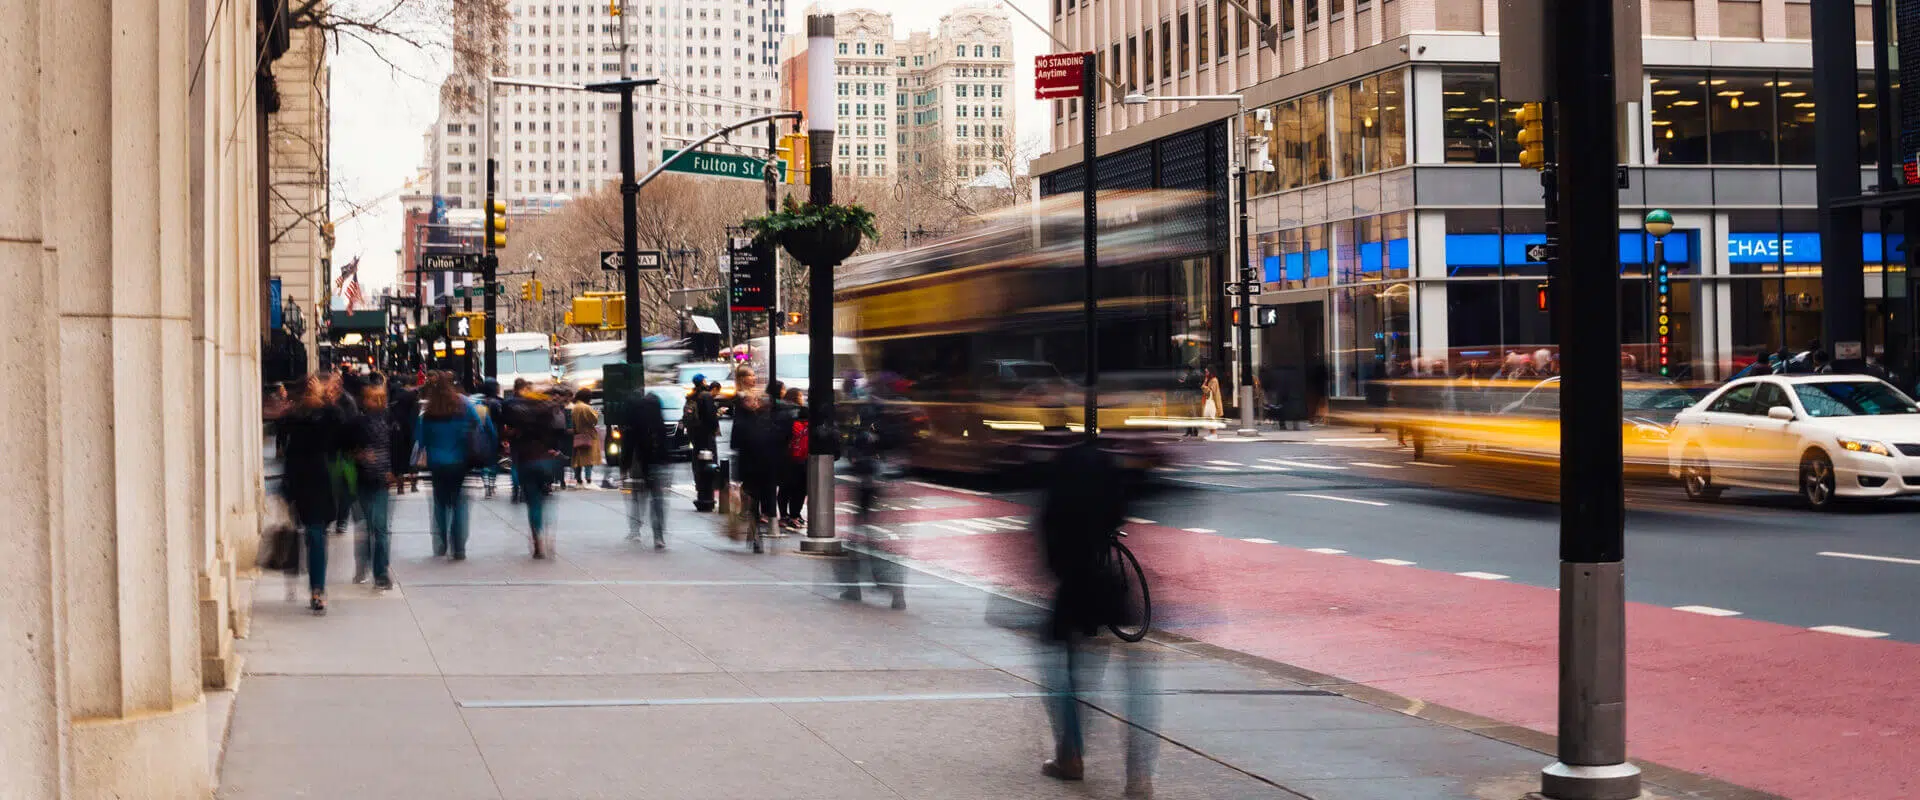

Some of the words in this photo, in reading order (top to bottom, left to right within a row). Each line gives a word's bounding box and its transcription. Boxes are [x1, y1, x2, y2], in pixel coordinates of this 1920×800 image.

[1038, 59, 1048, 68] NO
[1049, 56, 1084, 66] STANDING
[1038, 68, 1067, 80] Anytime
[694, 156, 736, 173] Fulton
[742, 162, 754, 175] St
[1728, 239, 1793, 256] CHASE
[427, 256, 454, 268] Fulton
